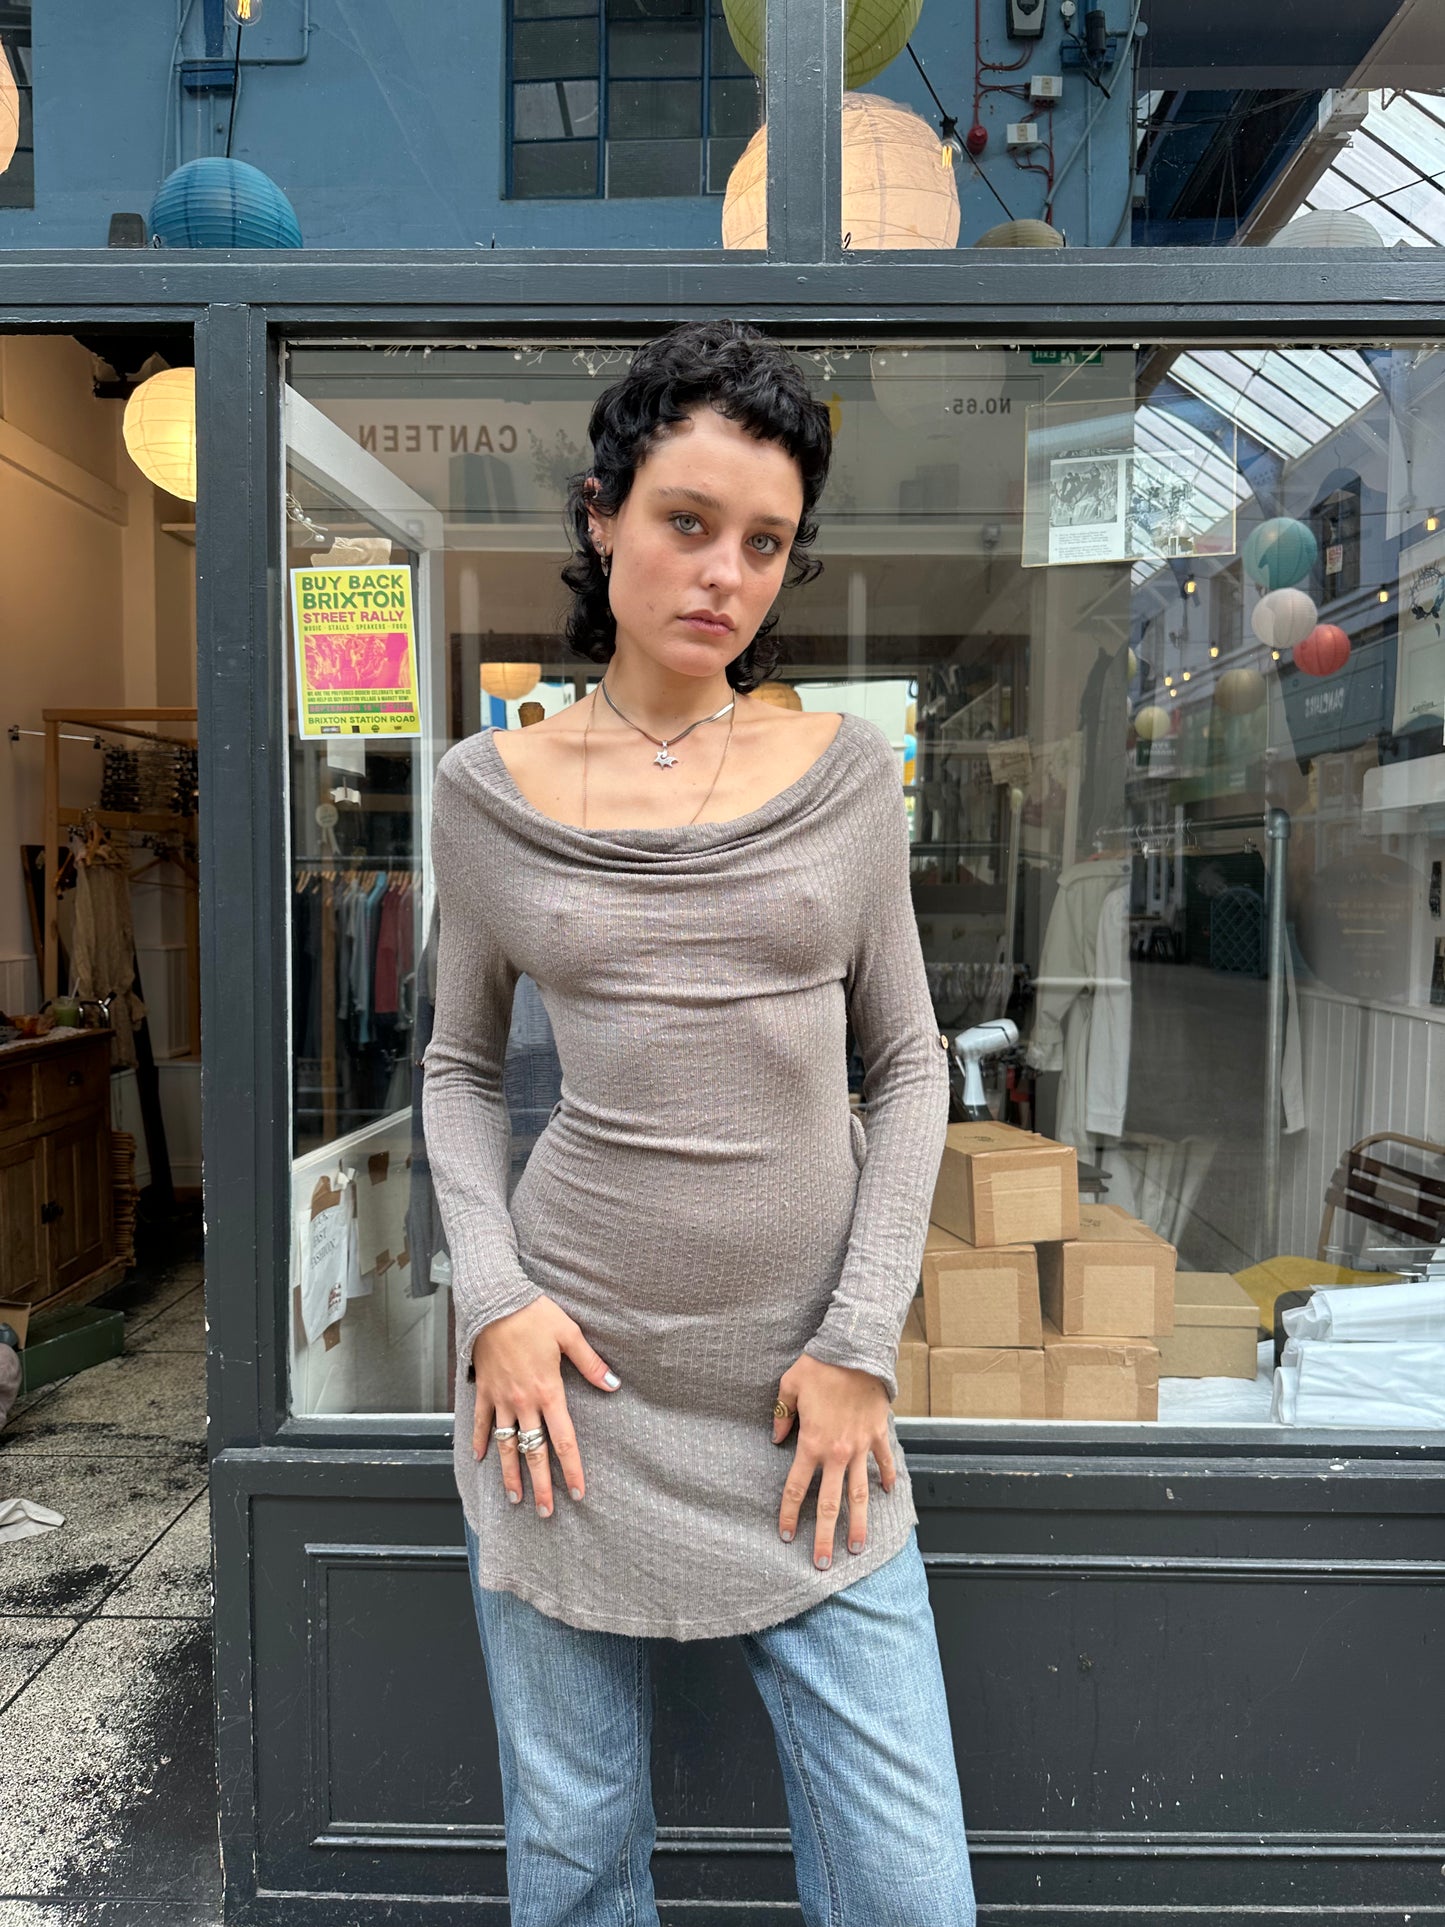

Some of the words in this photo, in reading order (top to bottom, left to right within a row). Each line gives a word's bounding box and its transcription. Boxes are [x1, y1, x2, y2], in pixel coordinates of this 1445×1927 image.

[302, 576, 342, 591] BUY
[348, 574, 404, 590] BACK
[303, 590, 406, 610] BRIXTON
[303, 611, 356, 624] STREET
[360, 610, 405, 622] RALLY
[308, 716, 347, 724] BRIXTON
[349, 716, 387, 724] STATION
[389, 715, 416, 723] ROAD
